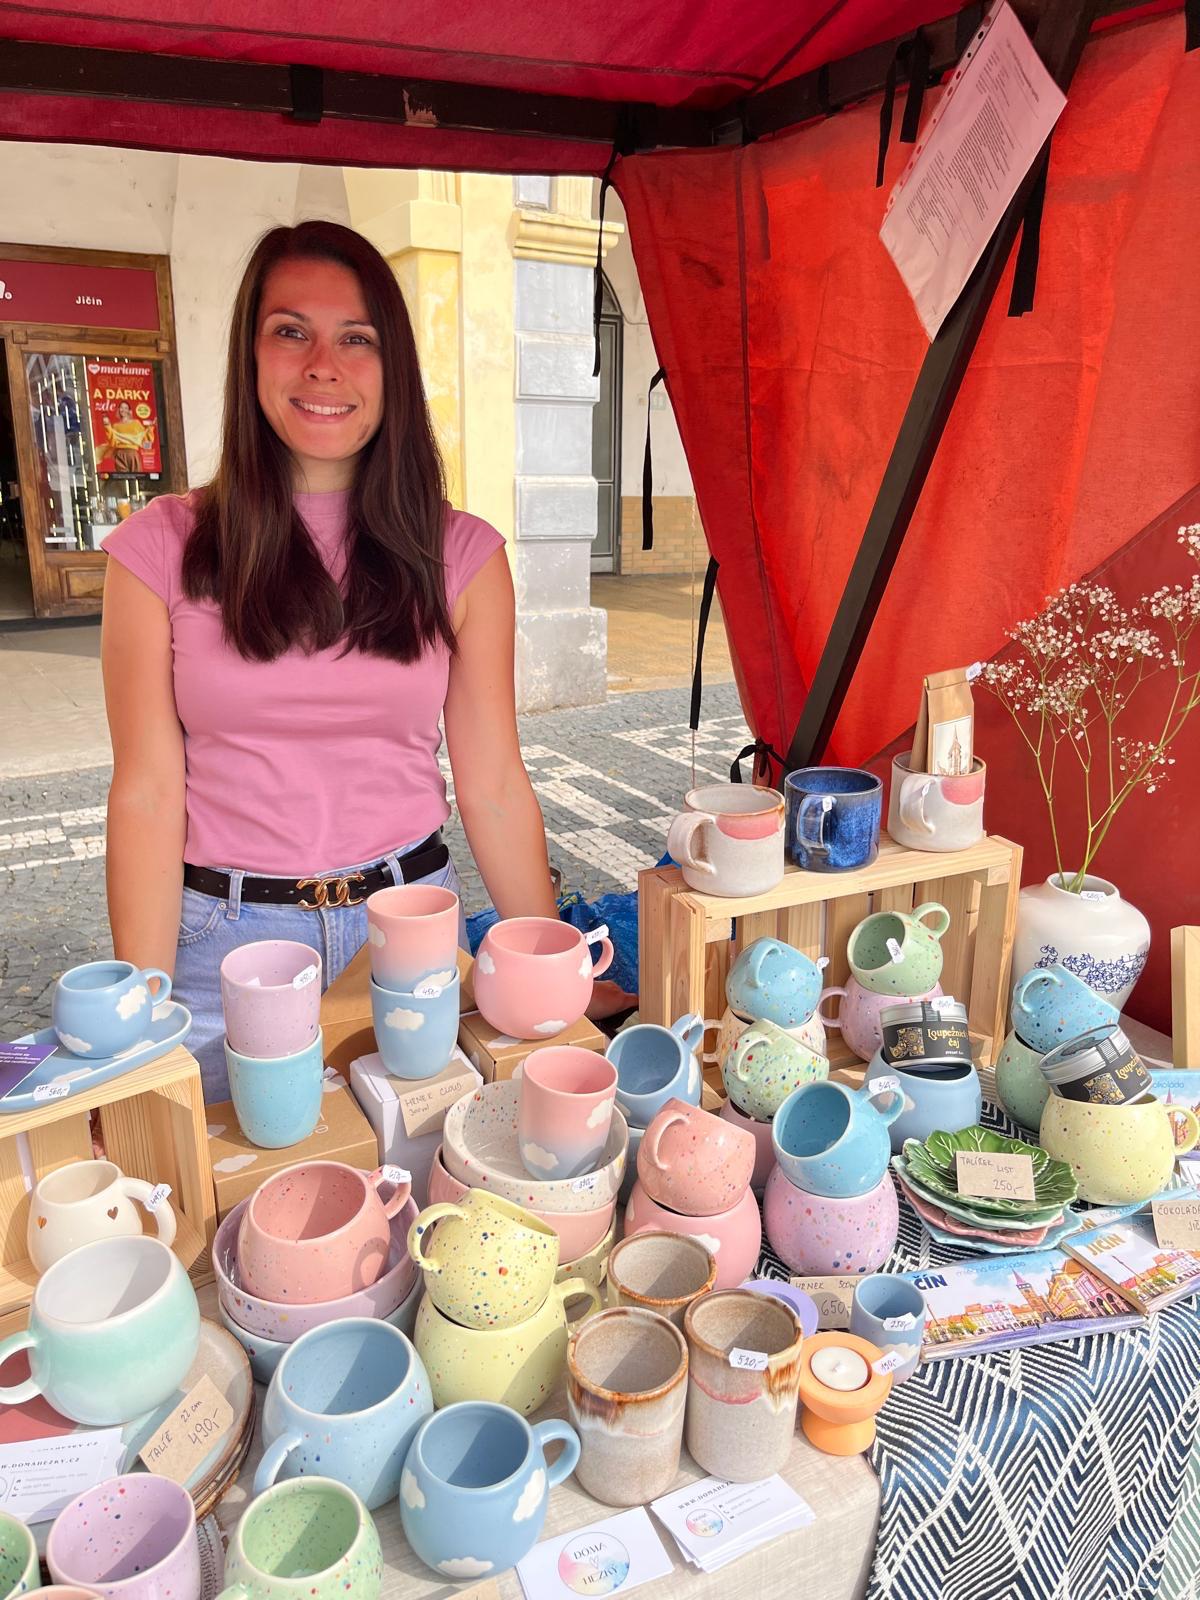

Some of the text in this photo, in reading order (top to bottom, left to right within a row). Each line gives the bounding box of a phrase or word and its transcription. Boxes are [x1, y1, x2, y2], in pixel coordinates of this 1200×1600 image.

[75, 295, 103, 306] Jičín
[100, 364, 151, 376] marianne
[93, 387, 150, 400] A DÁRKY
[95, 400, 116, 412] zde
[439, 1082, 462, 1096] CLOUD
[997, 1166, 1014, 1174] LIST
[993, 1179, 1025, 1195] 250,-
[1086, 1231, 1127, 1257] JIČÍN
[913, 1273, 948, 1291] ČÍN
[180, 1408, 191, 1423] 22
[191, 1400, 203, 1413] cm
[187, 1407, 220, 1445] 490,-
